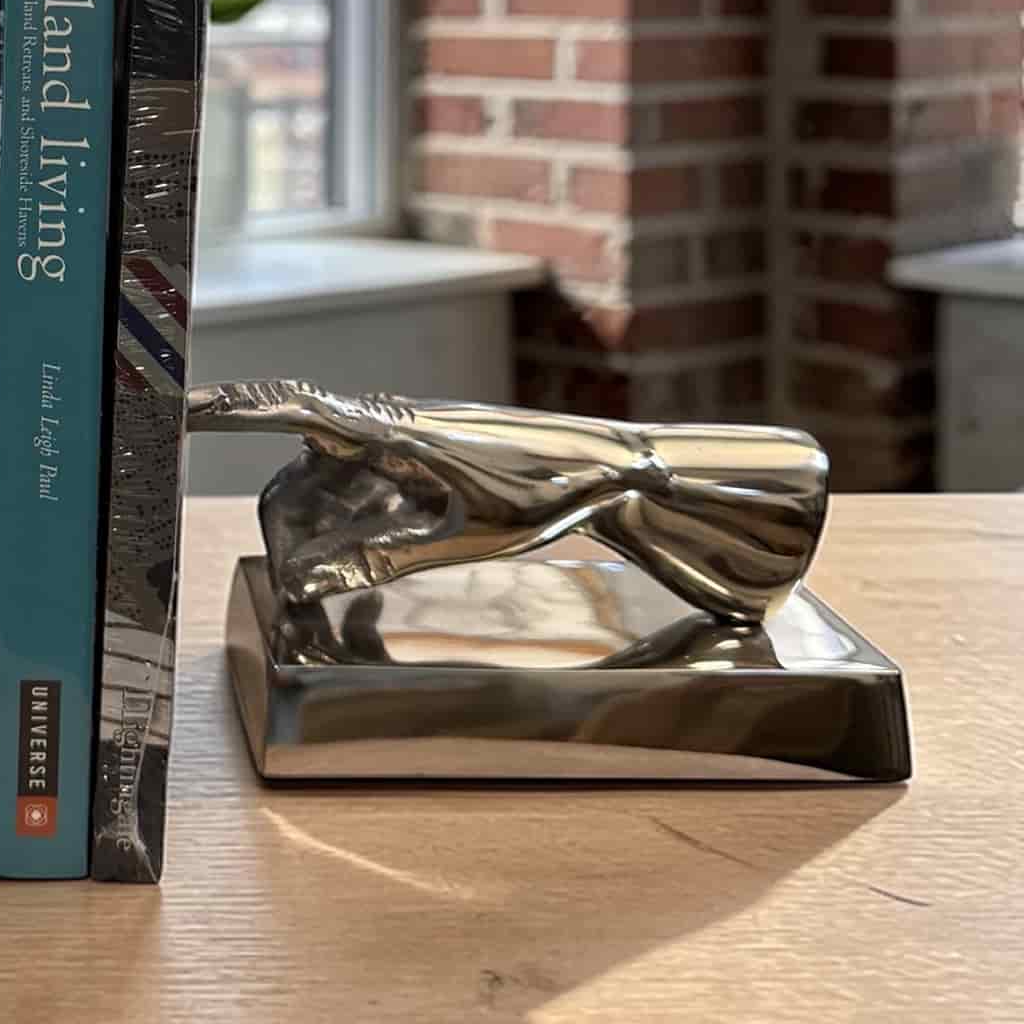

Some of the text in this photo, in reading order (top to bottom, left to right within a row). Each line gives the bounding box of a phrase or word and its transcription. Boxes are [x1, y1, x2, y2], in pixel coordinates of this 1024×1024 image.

[21, 36, 38, 92] Retreats
[20, 97, 36, 122] and
[19, 126, 35, 193] Shoreside
[17, 134, 91, 283] living
[17, 198, 34, 248] Havens
[33, 363, 61, 501] Linda Leigh Paul
[29, 686, 49, 789] UNIVERSE
